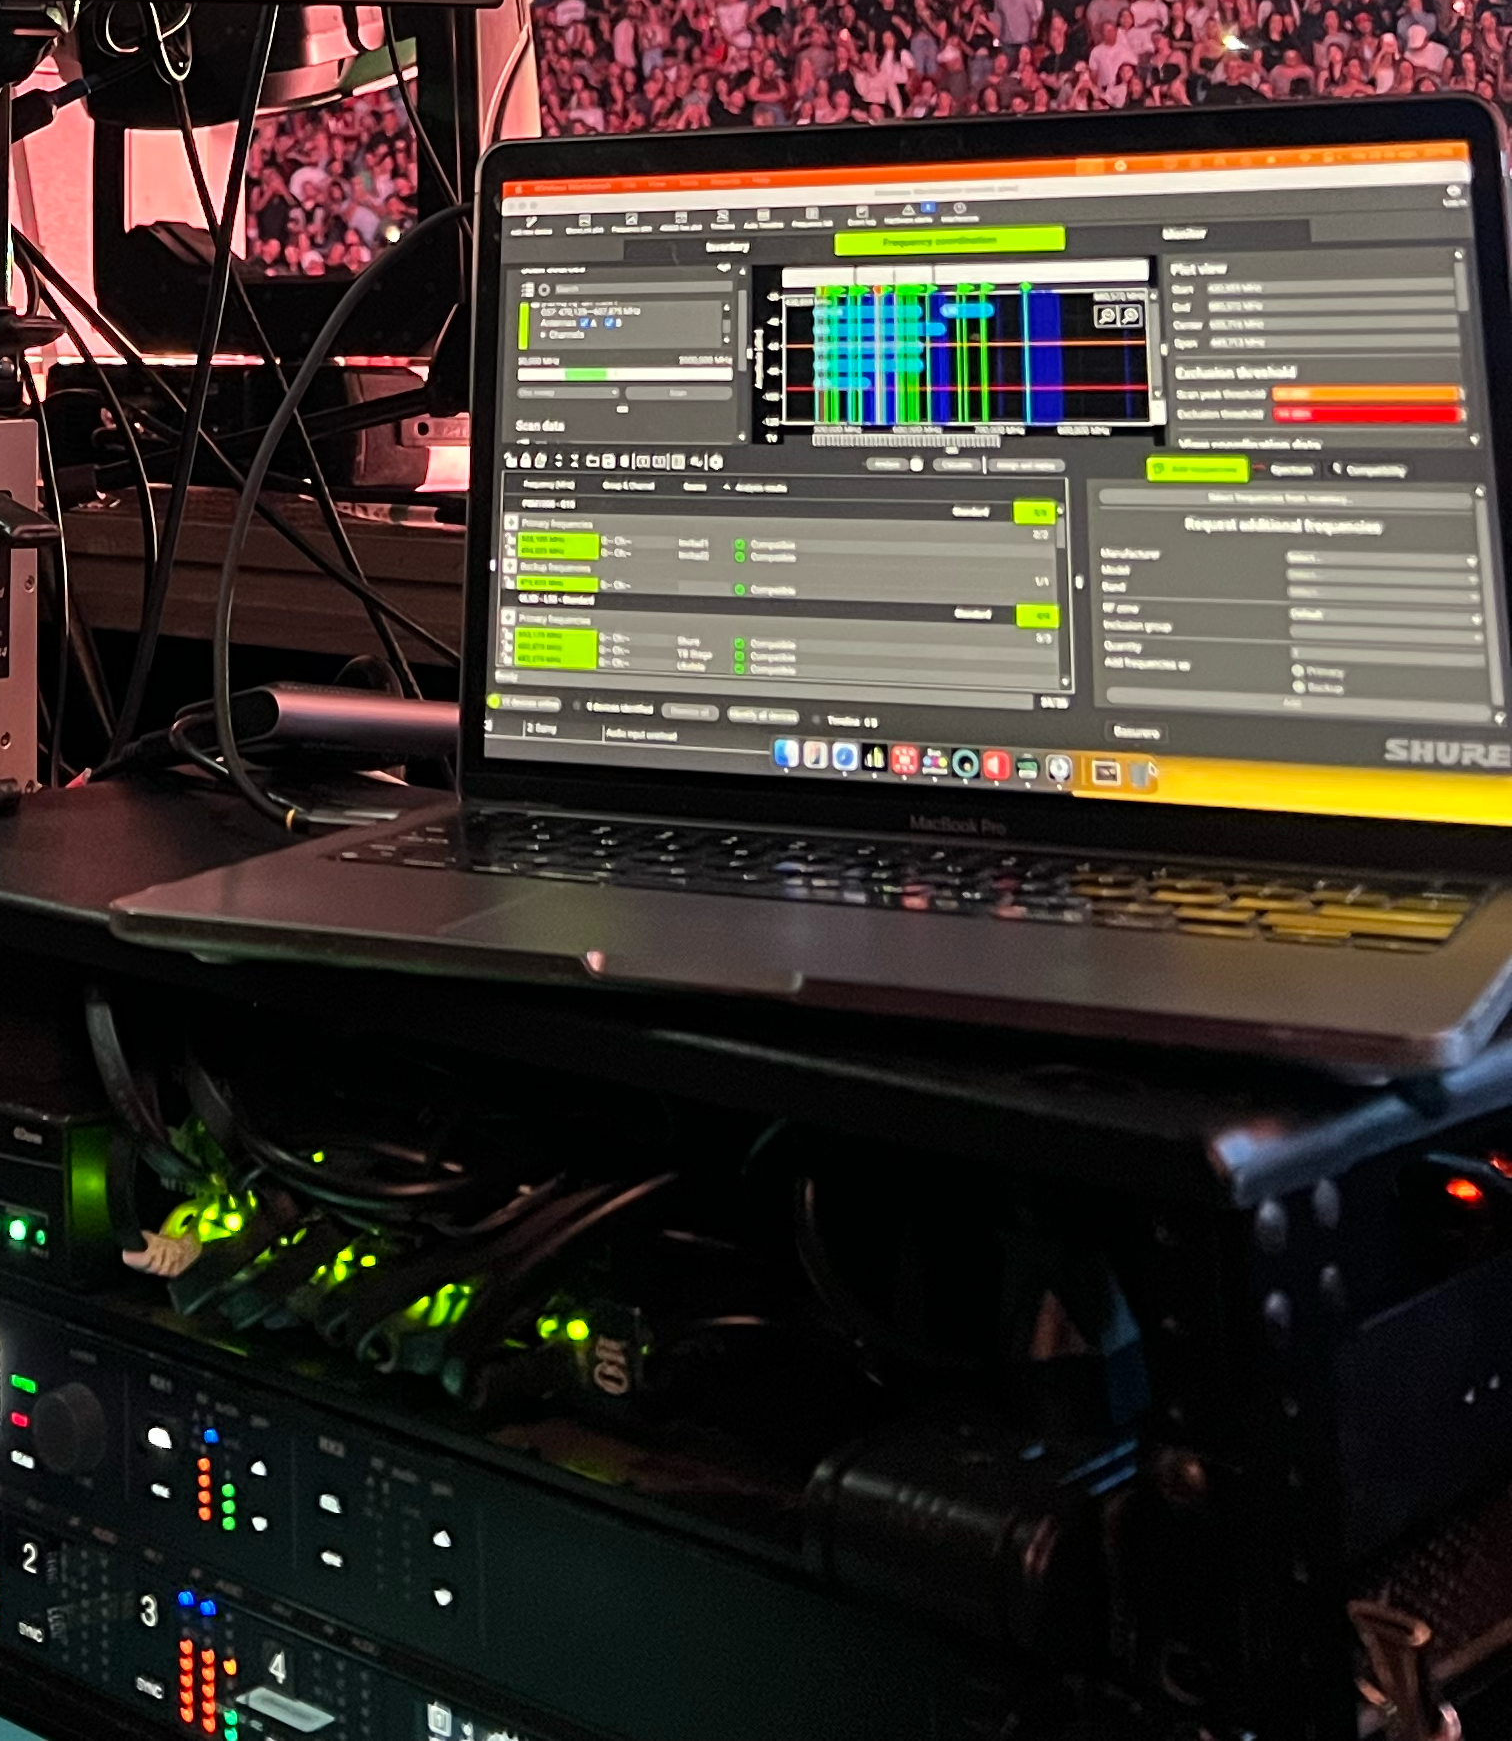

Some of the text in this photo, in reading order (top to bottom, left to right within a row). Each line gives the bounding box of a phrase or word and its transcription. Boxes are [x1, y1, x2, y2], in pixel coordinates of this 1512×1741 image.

[515, 419, 566, 432] Scan data
[1383, 738, 1511, 769] SHURE
[909, 814, 1007, 836] MacBook Pro
[22, 1542, 37, 1574] 2
[140, 1594, 158, 1627] 3
[268, 1651, 286, 1684] 4
